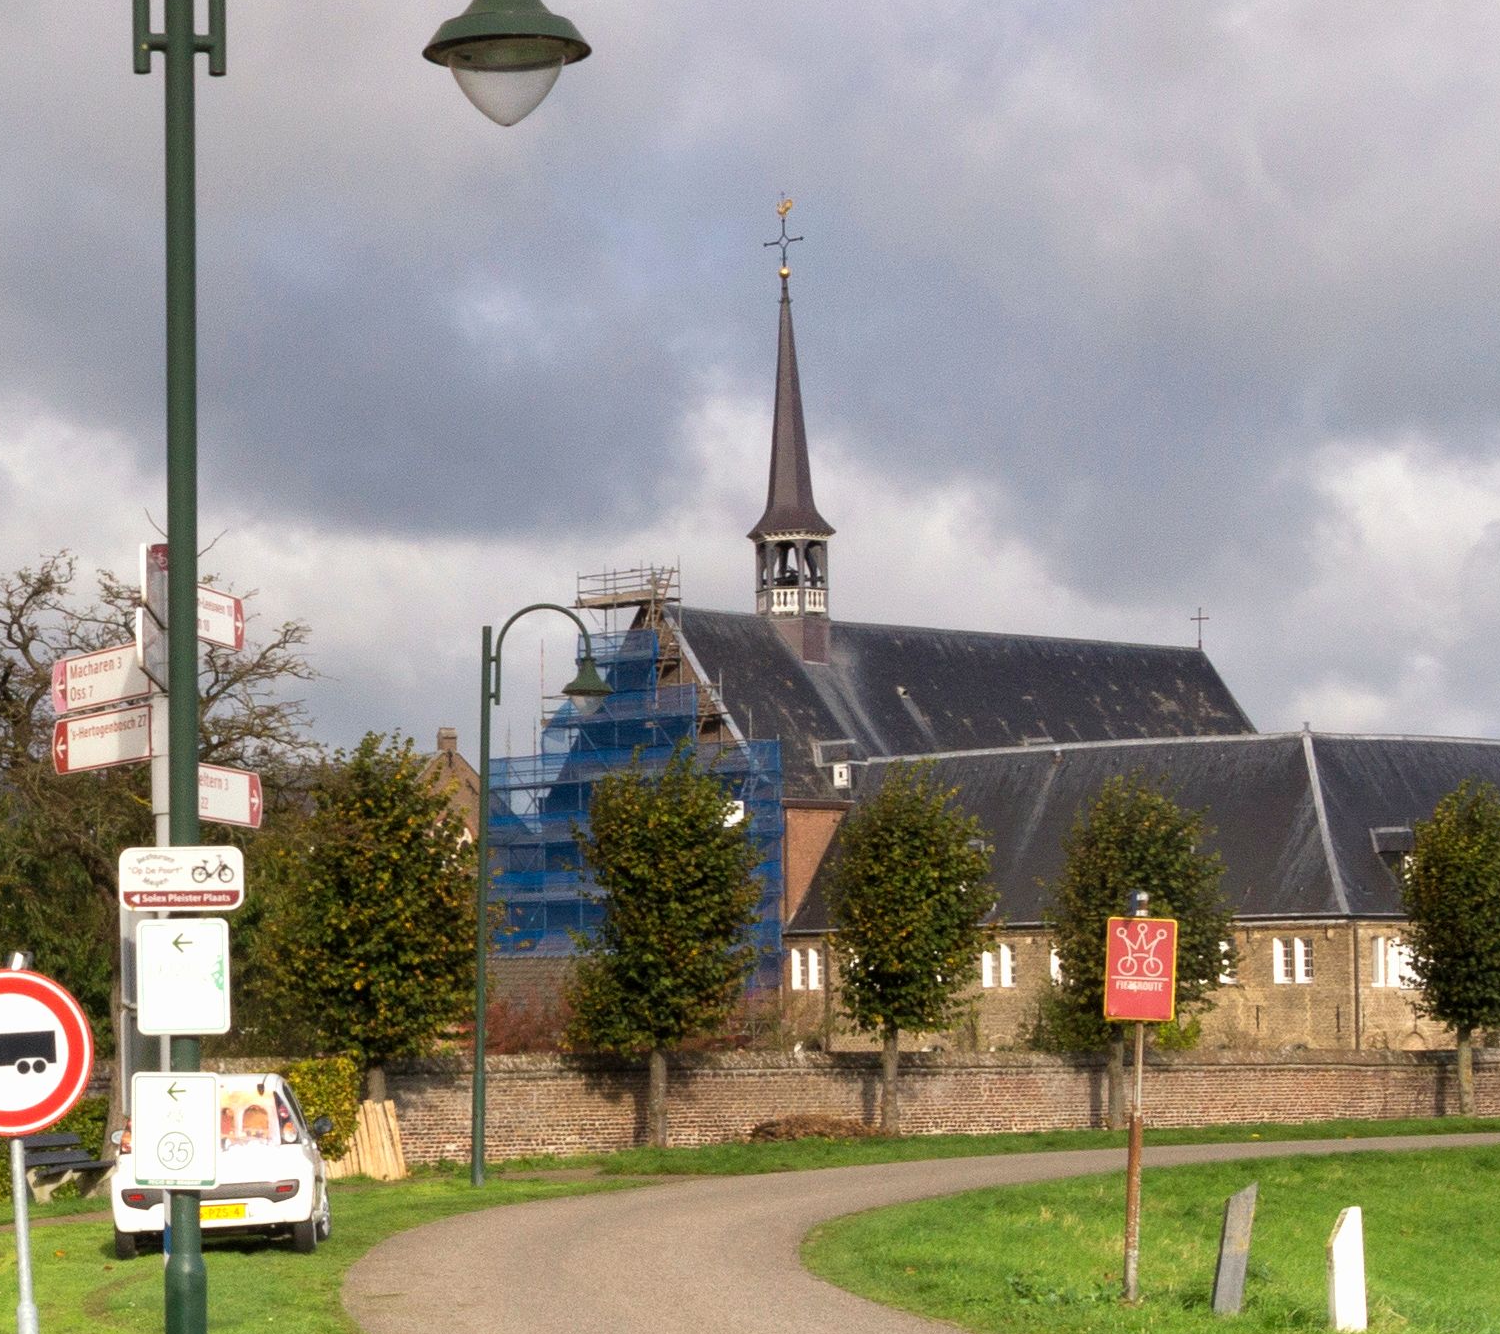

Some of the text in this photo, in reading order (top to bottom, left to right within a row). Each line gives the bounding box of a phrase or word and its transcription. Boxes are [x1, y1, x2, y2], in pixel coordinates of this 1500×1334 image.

[70, 656, 123, 679] Macharen 3
[70, 686, 87, 701] Oss
[142, 893, 231, 902] Solex Pleister Plaats
[162, 1141, 190, 1163] 35
